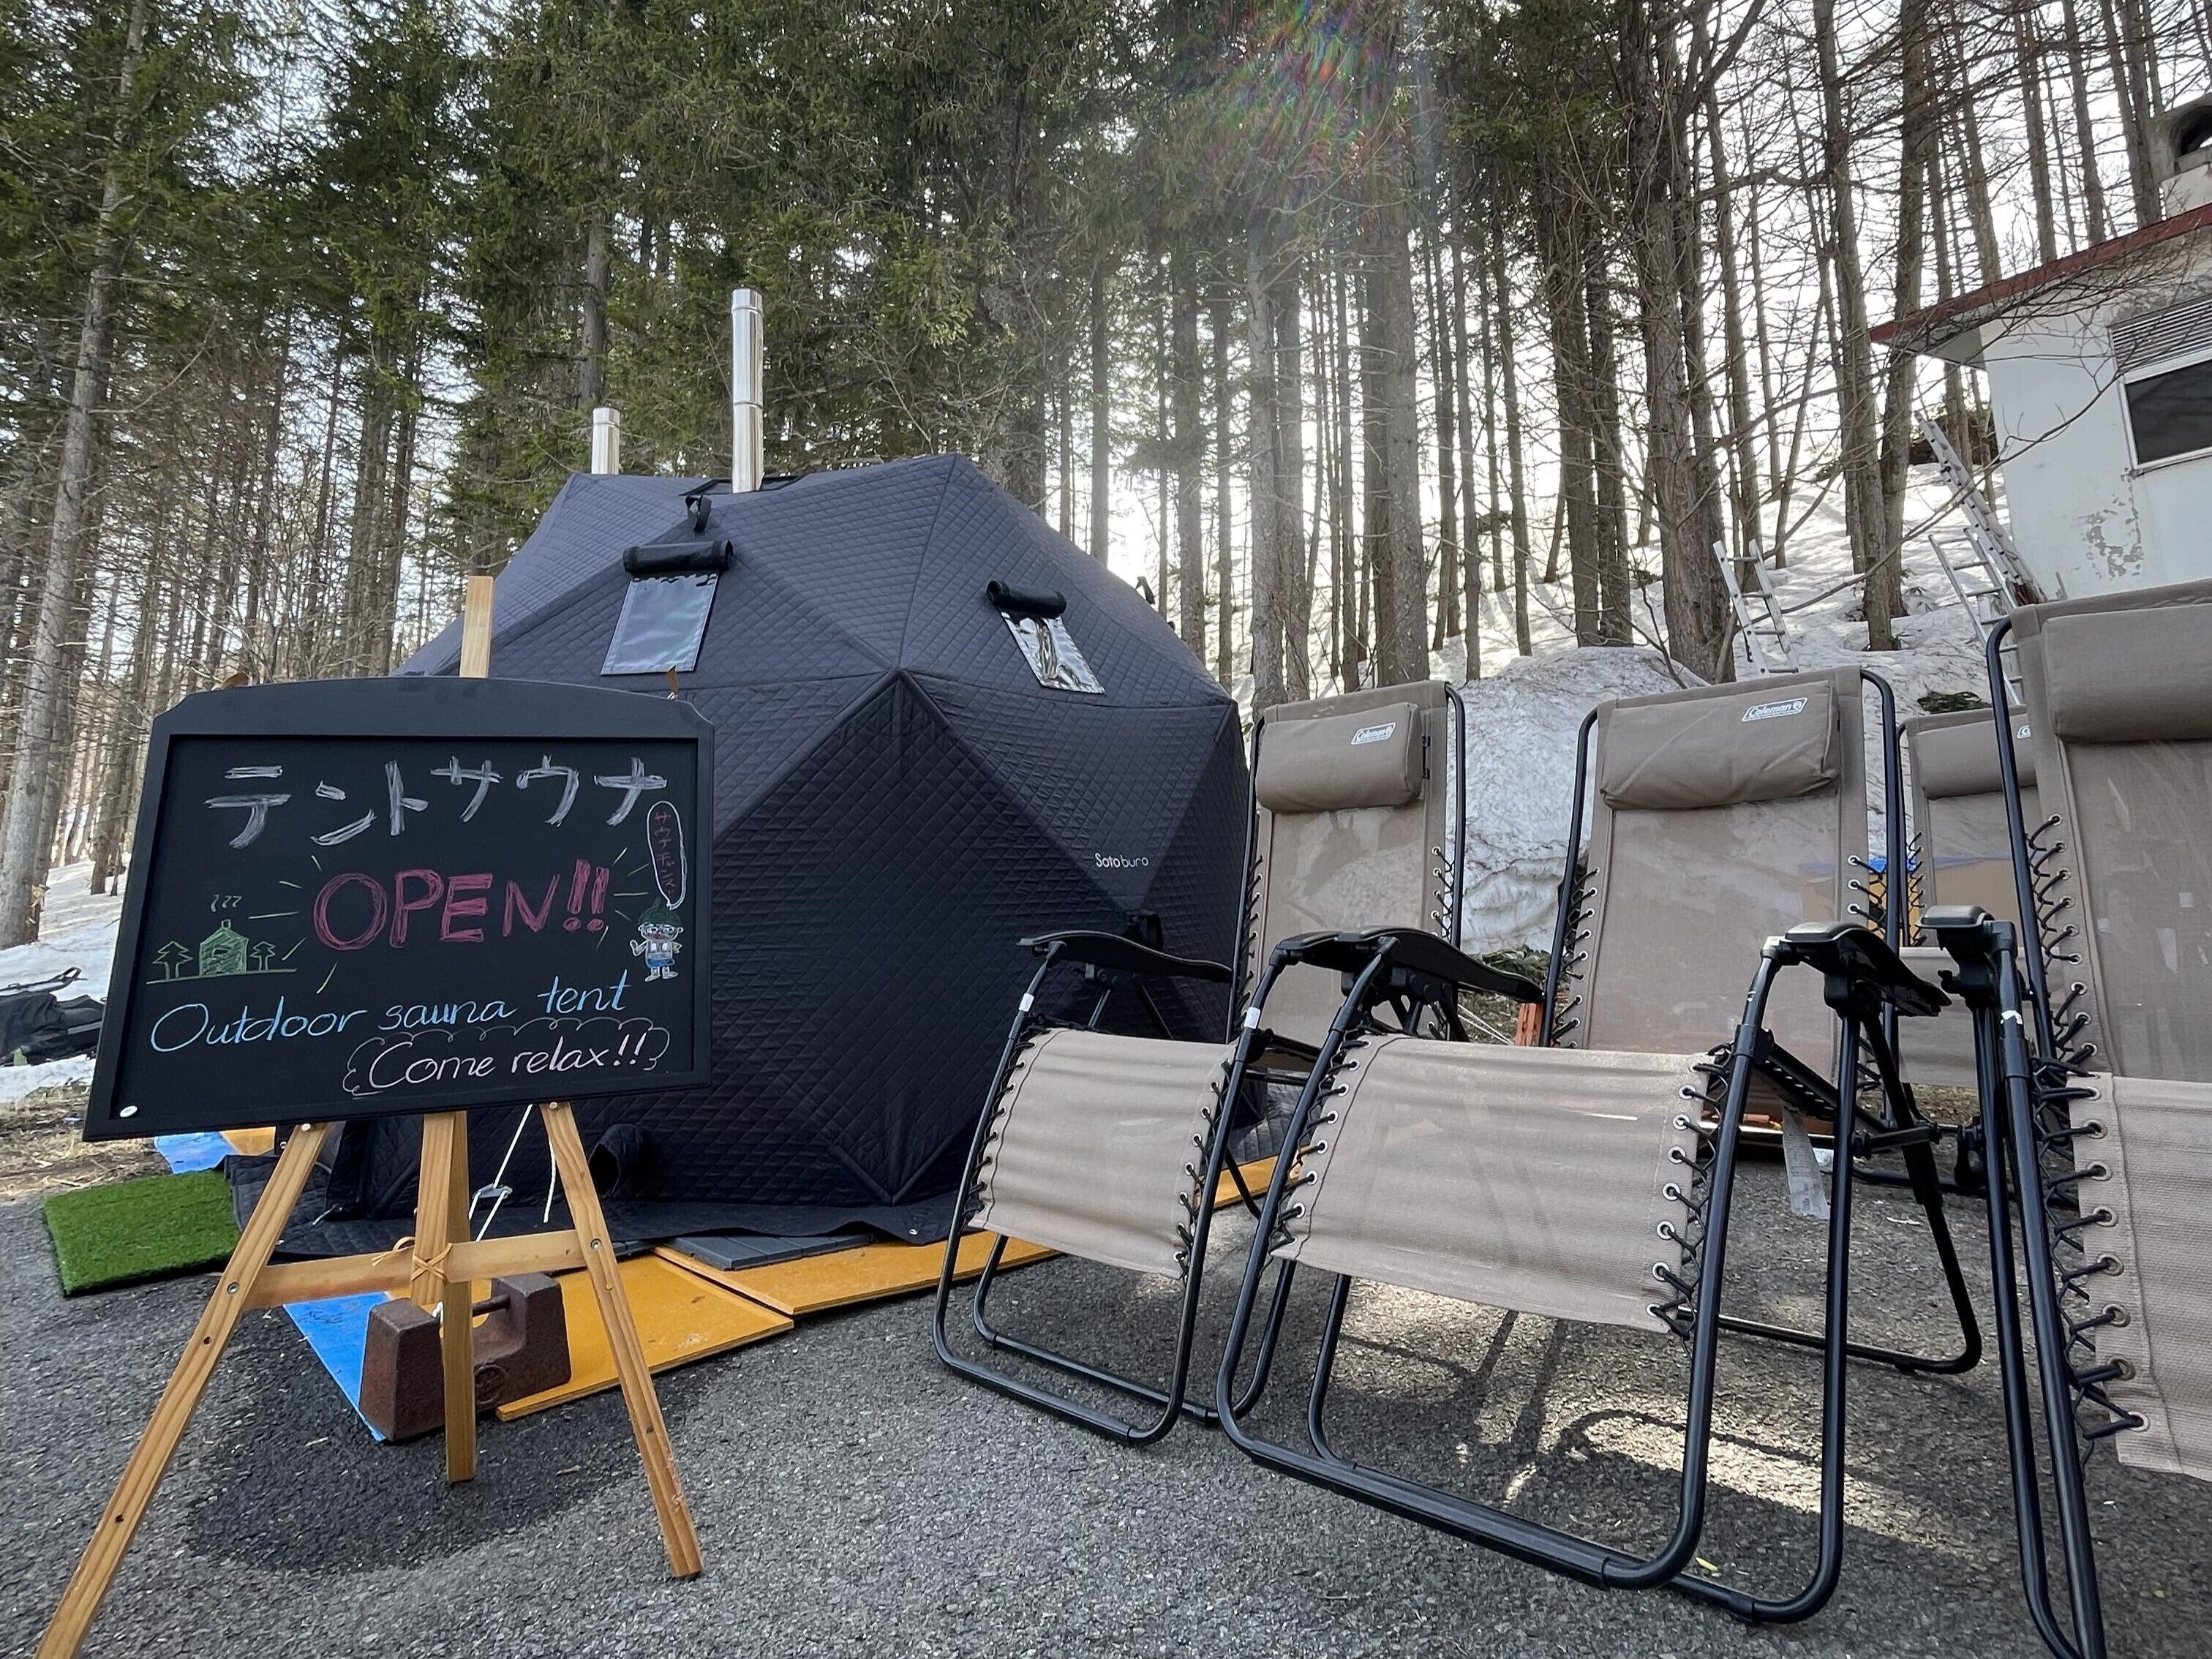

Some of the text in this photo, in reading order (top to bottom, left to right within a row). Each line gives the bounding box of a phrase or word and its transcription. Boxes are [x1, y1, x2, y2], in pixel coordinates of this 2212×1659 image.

[1748, 704, 1792, 718] Coleman
[205, 755, 667, 849] テントサウナ
[313, 859, 610, 949] OPEN!!
[151, 969, 632, 1052] Outdoor sauna tent
[369, 1032, 647, 1088] Come relax!!
